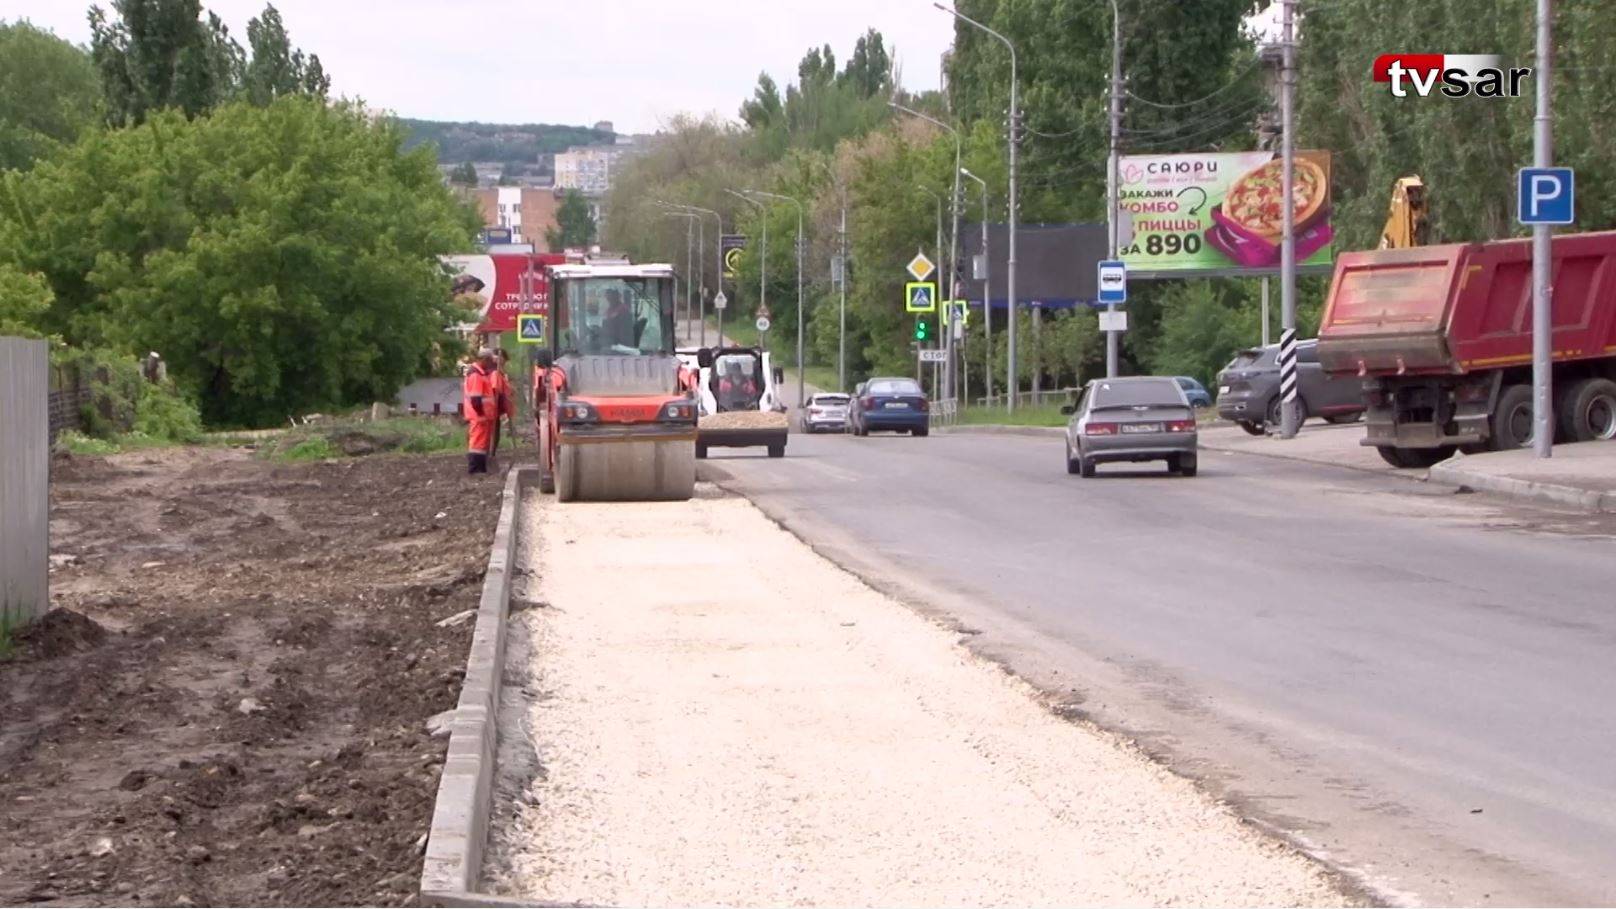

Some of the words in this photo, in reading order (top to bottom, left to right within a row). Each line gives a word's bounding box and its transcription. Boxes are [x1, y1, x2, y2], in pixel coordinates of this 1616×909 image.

[1531, 175, 1562, 216] P
[1139, 219, 1201, 232] ПИЦЦЫ
[1146, 233, 1202, 256] 890
